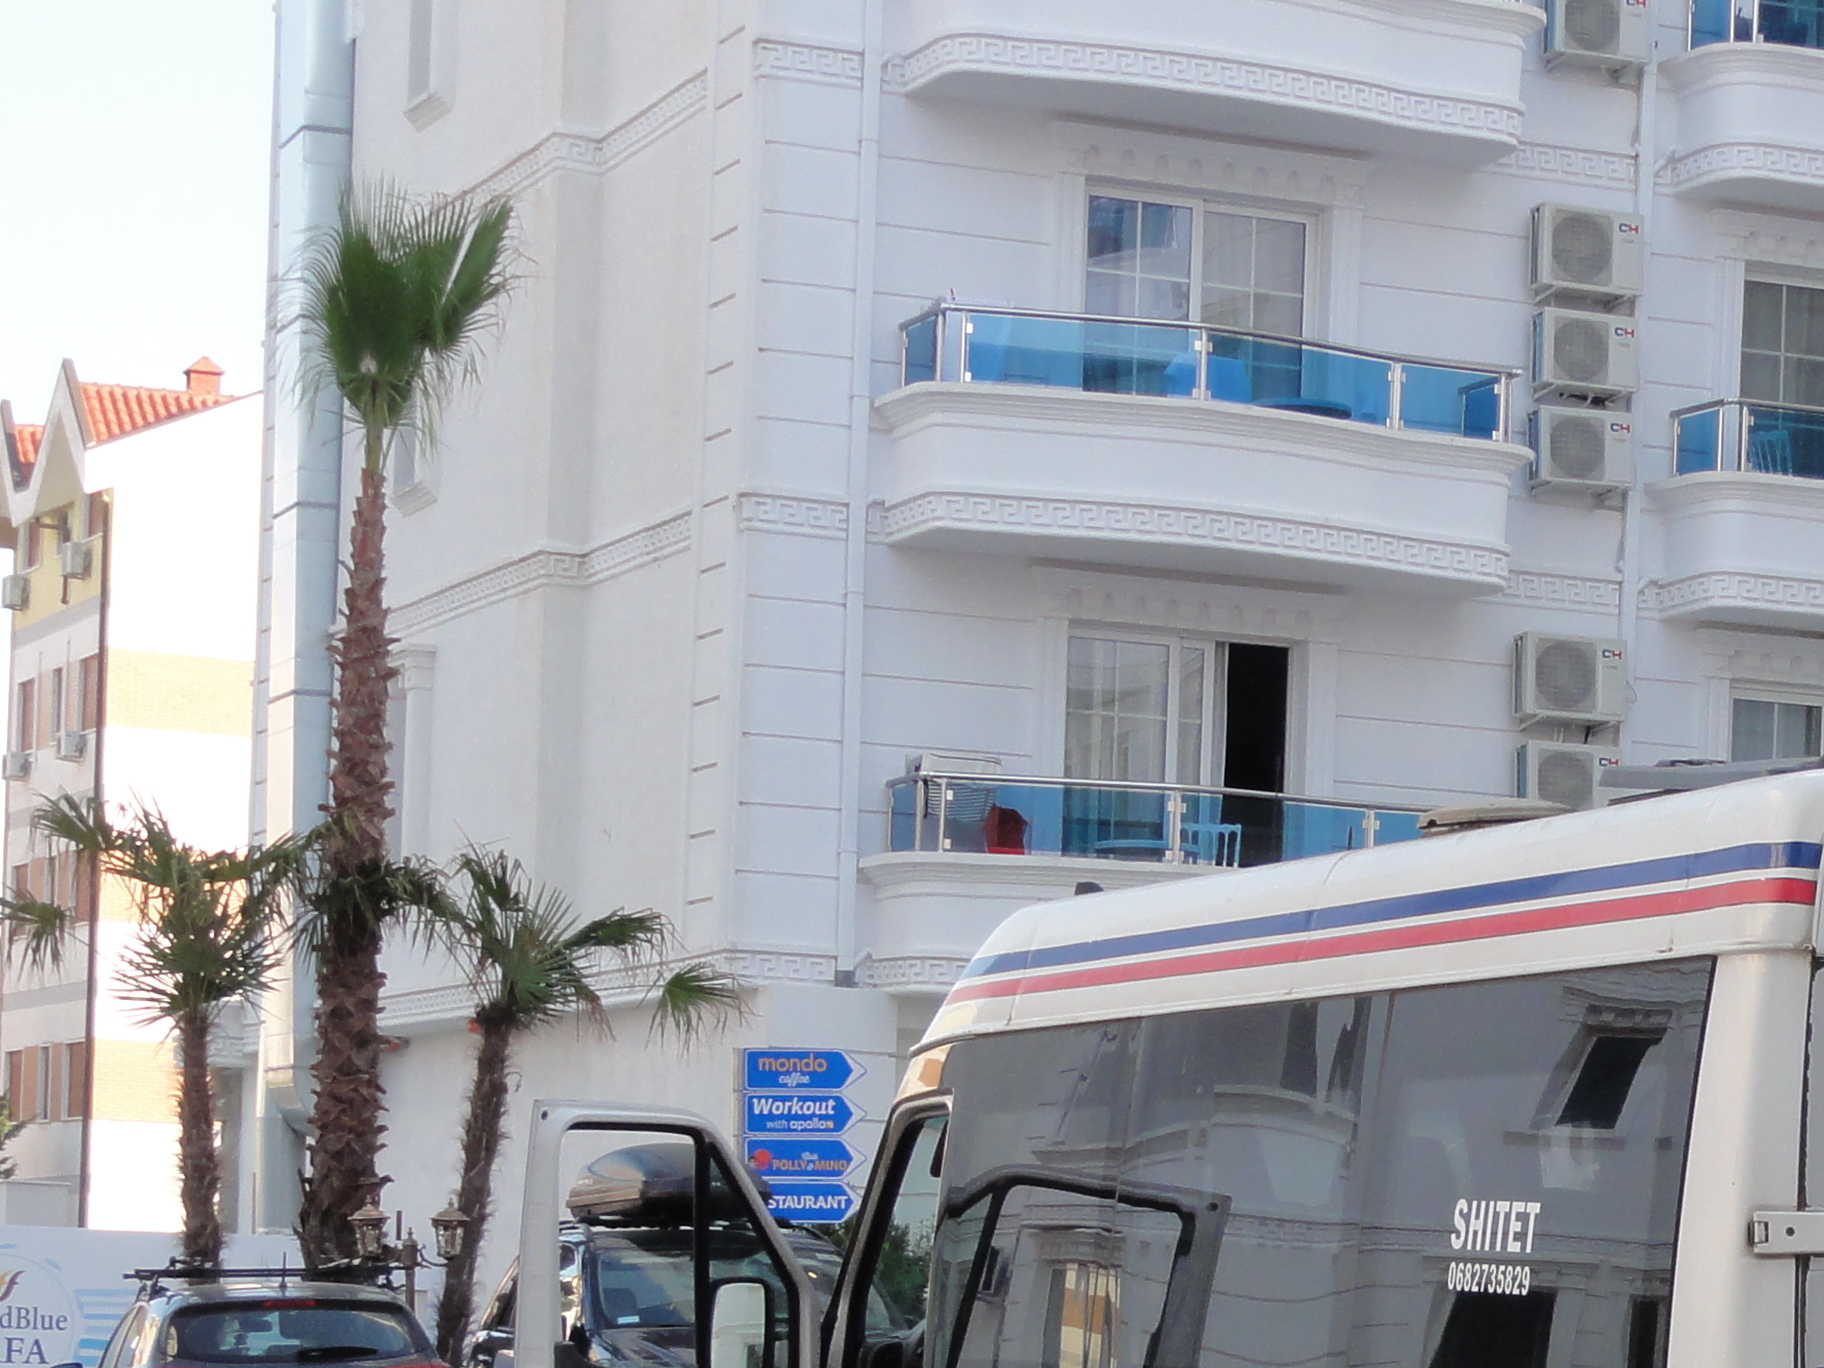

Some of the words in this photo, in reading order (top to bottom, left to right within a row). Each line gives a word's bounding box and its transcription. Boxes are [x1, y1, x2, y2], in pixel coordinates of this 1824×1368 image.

[1619, 223, 1639, 234] CH
[1614, 327, 1635, 338] CH
[1610, 422, 1630, 434] CH
[1602, 649, 1622, 660] CH
[758, 1053, 828, 1072] mondo
[753, 1096, 836, 1115] Workout
[766, 1119, 788, 1129] with
[790, 1117, 834, 1131] apollon
[768, 1195, 848, 1209] STAURANT
[1450, 1198, 1541, 1253] SHITET
[1447, 1261, 1531, 1296] 0682735829
[0, 1337, 49, 1365] FA
